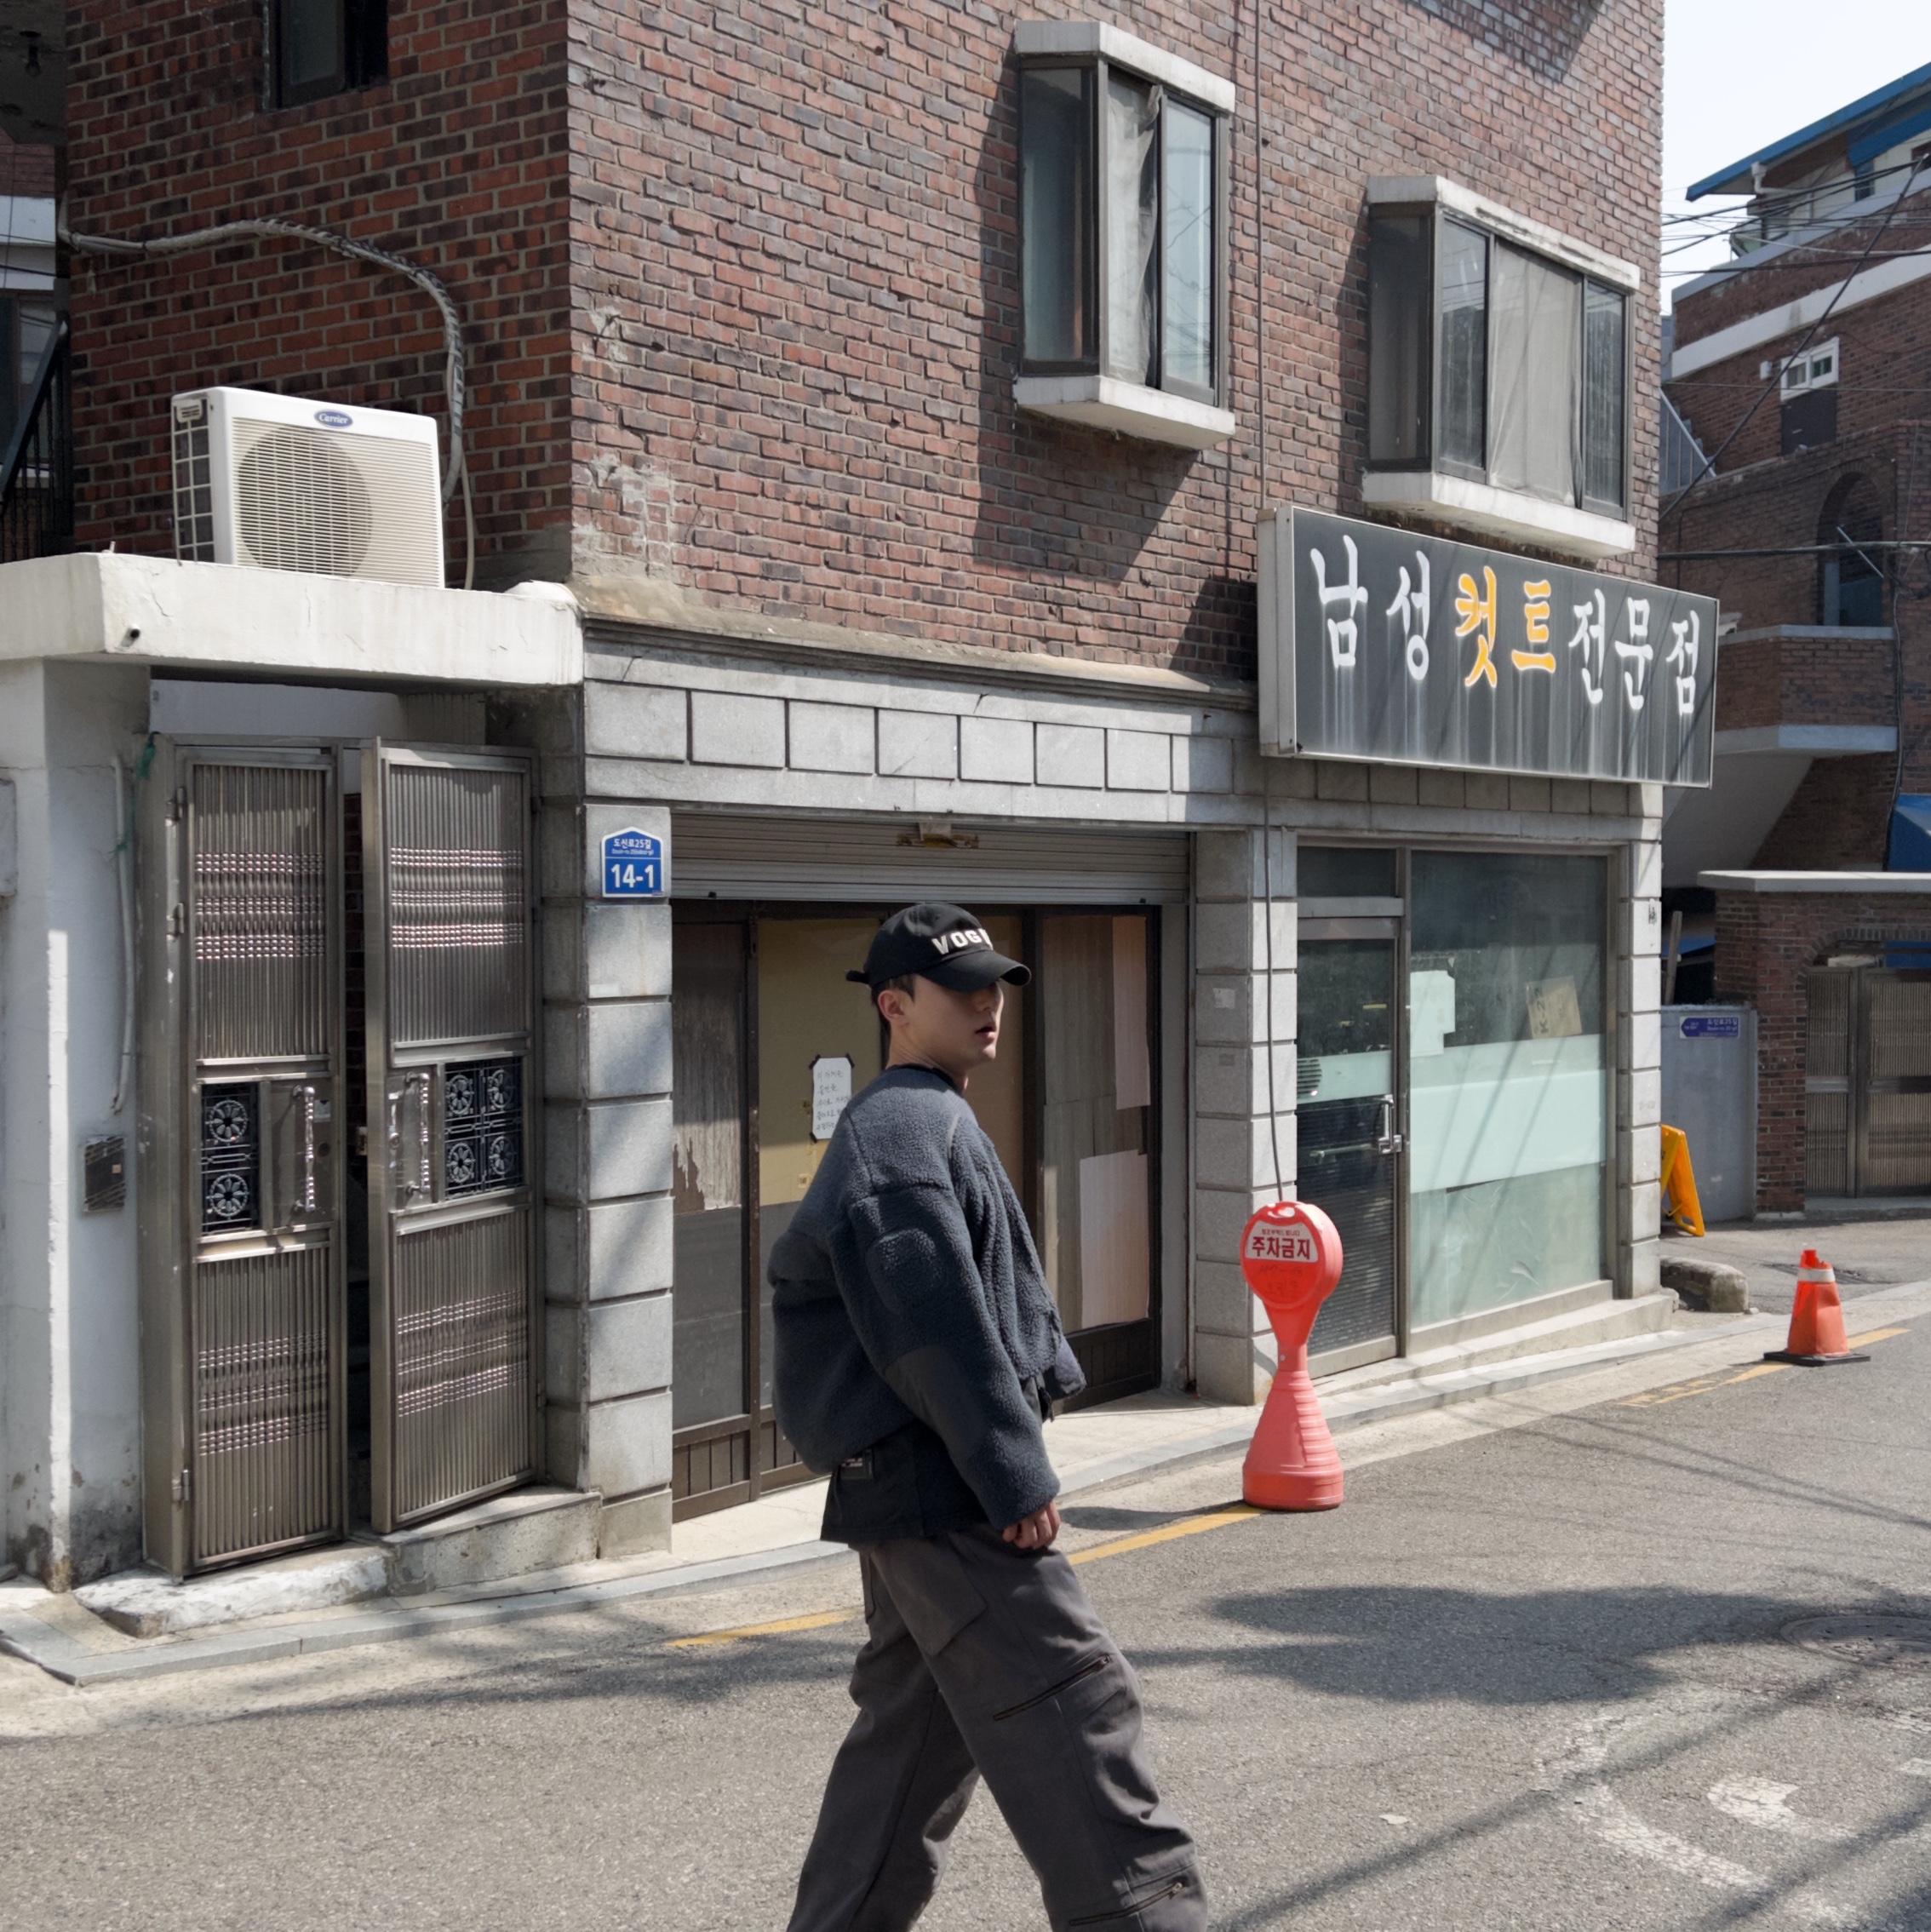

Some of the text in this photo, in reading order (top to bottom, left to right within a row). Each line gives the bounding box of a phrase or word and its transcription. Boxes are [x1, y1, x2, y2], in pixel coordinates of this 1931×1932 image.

[318, 413, 349, 424] Carrier
[613, 838, 651, 850] 도신로25길
[610, 863, 654, 888] 14-1
[1252, 1236, 1310, 1260] 주차금지
